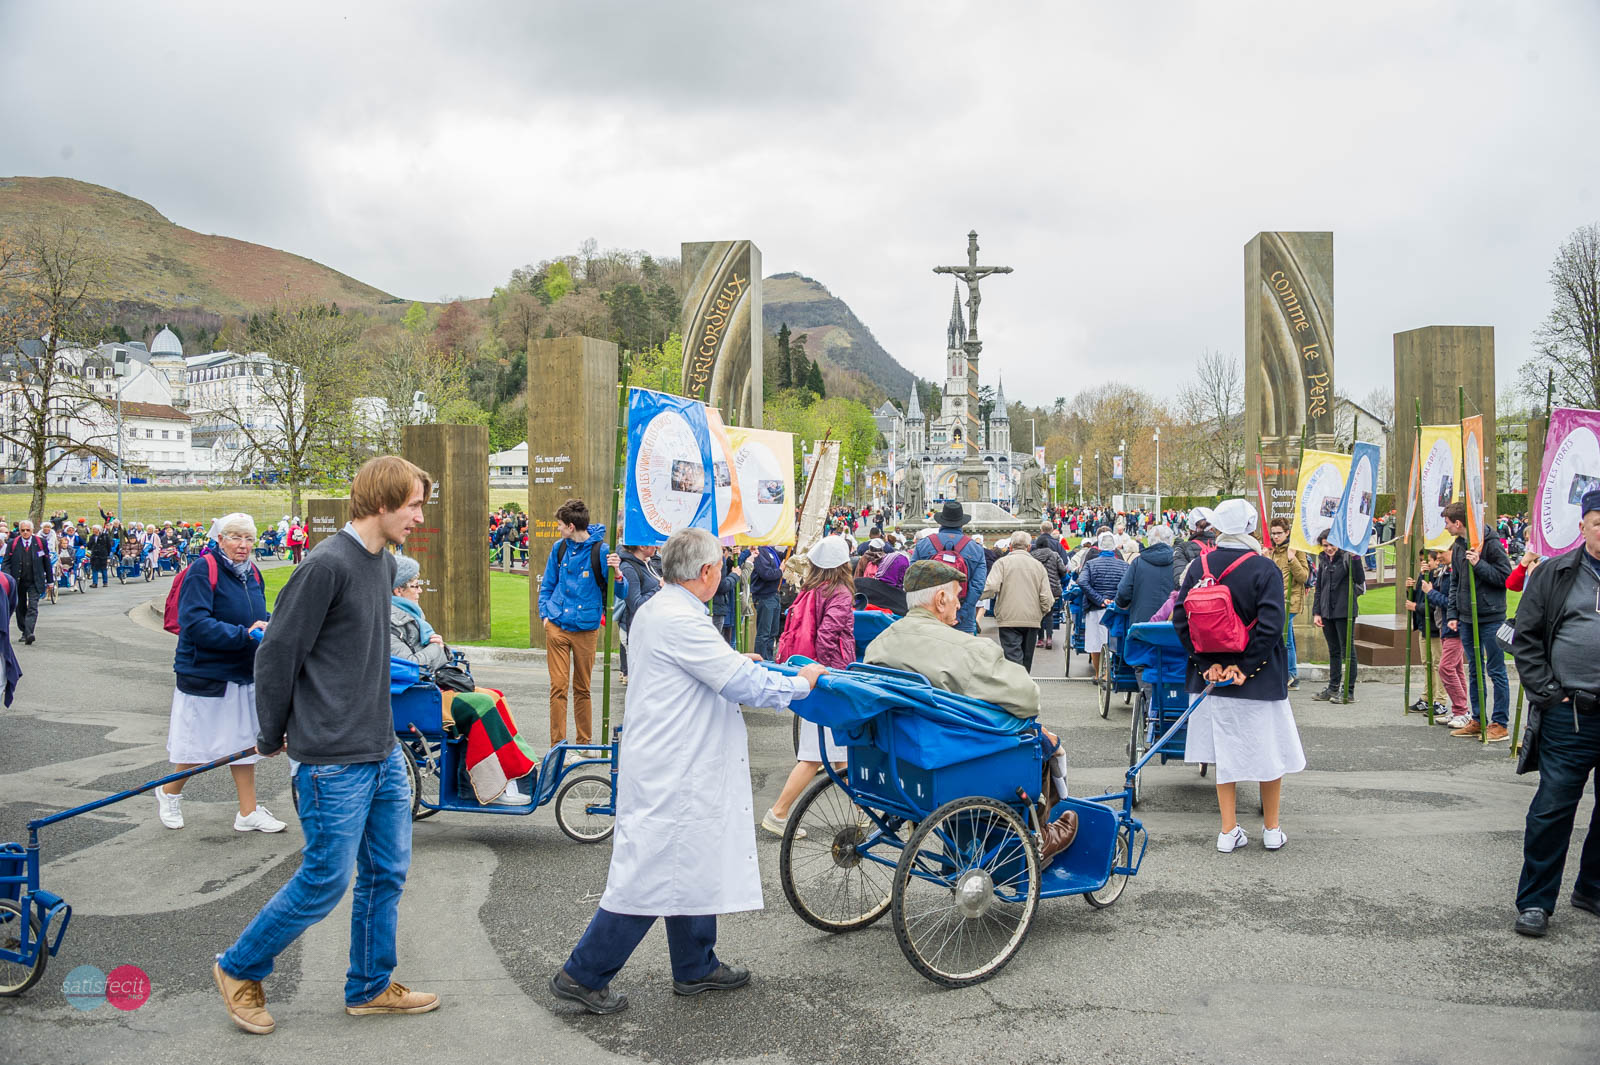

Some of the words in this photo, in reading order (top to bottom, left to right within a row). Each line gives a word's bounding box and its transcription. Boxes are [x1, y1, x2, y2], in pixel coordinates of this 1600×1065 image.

[639, 472, 650, 486] LES
[1270, 488, 1297, 499] Quiconqu
[1543, 486, 1554, 535] ENSEVELIR
[1550, 468, 1558, 484] LES
[1555, 439, 1574, 466] MORTS
[640, 487, 653, 504] POUR
